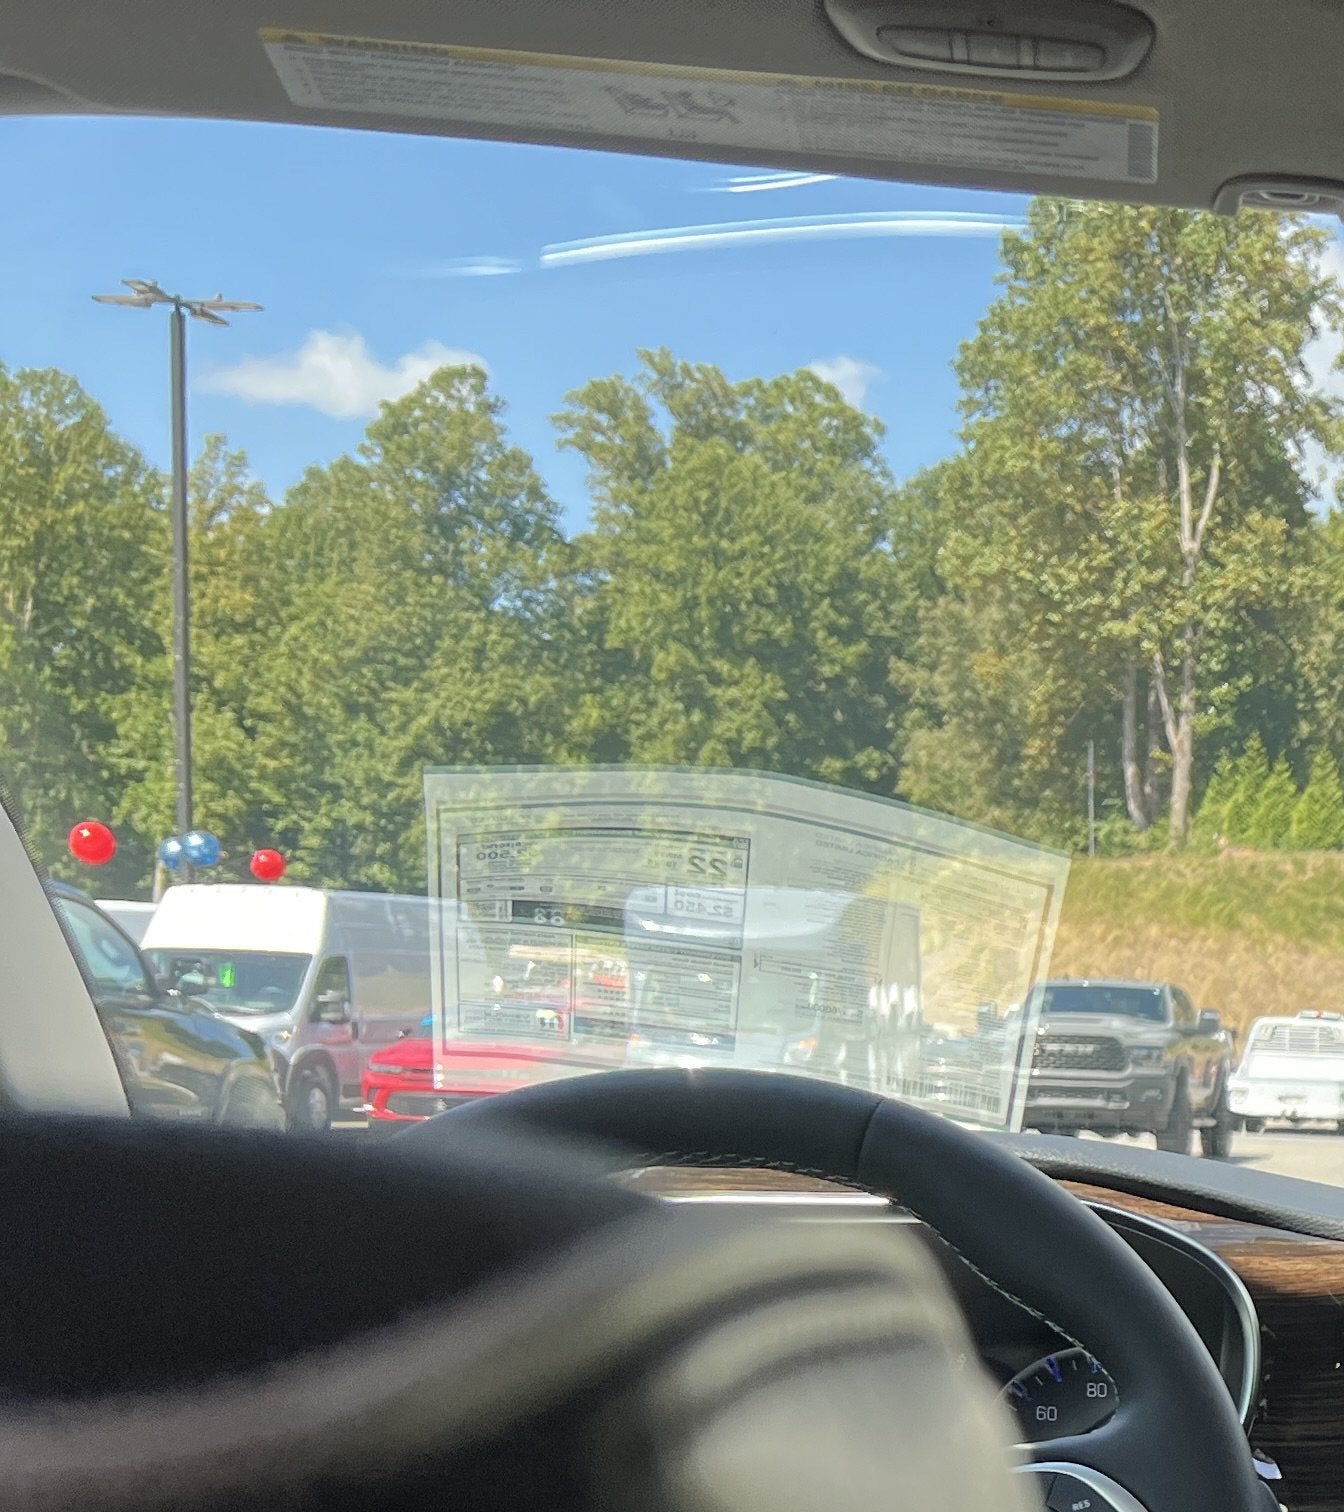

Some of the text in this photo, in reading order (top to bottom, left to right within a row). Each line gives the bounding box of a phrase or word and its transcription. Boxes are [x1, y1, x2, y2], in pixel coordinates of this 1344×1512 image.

[1086, 1382, 1108, 1398] 80
[1036, 1405, 1058, 1422] 60
[1072, 1499, 1091, 1511] RES
